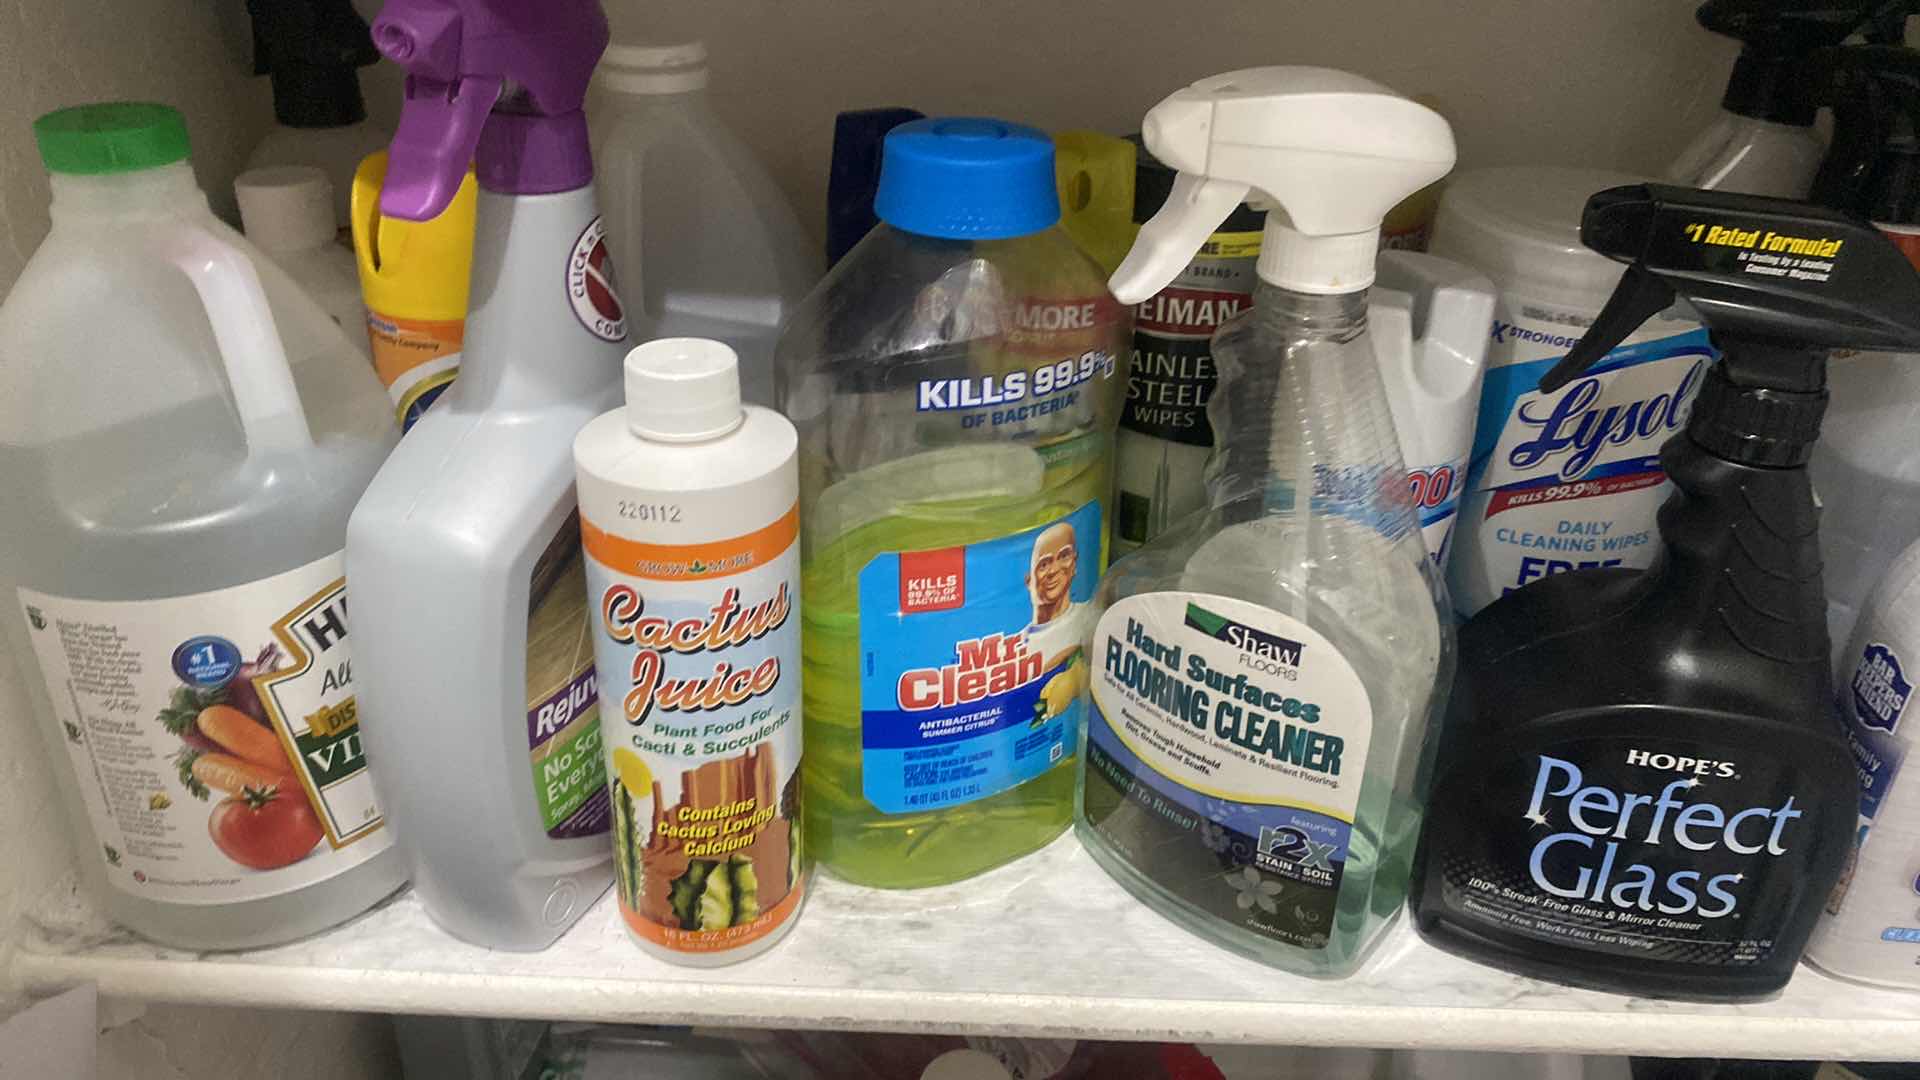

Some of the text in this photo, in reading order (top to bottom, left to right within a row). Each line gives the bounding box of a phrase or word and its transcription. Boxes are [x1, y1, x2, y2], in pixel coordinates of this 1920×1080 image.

[1684, 223, 1843, 257] #1 Rated Formula!
[573, 247, 589, 298] CLICK
[1016, 303, 1096, 330] MORE
[1139, 297, 1239, 326] EIMAN
[1131, 349, 1218, 380] AINLE
[919, 350, 1116, 411] KILLS 99.9%
[1128, 376, 1208, 407] STEEL
[961, 412, 986, 430] OF
[1134, 404, 1196, 428] WIPES
[1508, 358, 1706, 479] Lysol
[1507, 491, 1544, 506] KILLS
[1544, 482, 1601, 501] 99.9%
[616, 500, 682, 522] 220112
[1496, 528, 1649, 552] CLEANING WIPES
[1557, 520, 1613, 535] DAILY
[908, 575, 957, 591] KILLS
[304, 597, 348, 652] H
[601, 581, 791, 654] Cactus
[956, 632, 1028, 673] Mr.
[1227, 625, 1298, 666] Shaw
[898, 650, 1044, 710] Clean
[1127, 615, 1321, 724] Hard Surfaces
[1239, 653, 1297, 681] FLOORS
[1871, 652, 1896, 685] BAR
[623, 648, 780, 726] Juice
[328, 700, 356, 730] DIS
[653, 703, 774, 738] Plant Food For
[918, 706, 1003, 730] ANTIBACTERIAL
[1105, 634, 1344, 776] FLOORING CLEANER
[631, 710, 791, 756] Cacti & Succulents
[922, 725, 963, 739] SUMMER
[543, 752, 572, 783] No
[575, 727, 600, 760] Scr
[1153, 728, 1175, 748] Tough
[1176, 742, 1221, 770] Household
[1167, 749, 1184, 763] and
[1626, 748, 1736, 779] HOPE'S
[678, 797, 757, 822] Contains
[1136, 784, 1152, 805] To
[1525, 755, 1801, 856] Perfect
[656, 804, 776, 839] Cactus Loving
[1290, 815, 1337, 837] featuring
[683, 832, 756, 857] Calcium
[1256, 852, 1333, 881] STAIN SOIL
[1528, 831, 1740, 918] Glass
[1570, 903, 1604, 918] Glass
[1604, 908, 1615, 920] &
[1617, 912, 1656, 926] Mirror
[1657, 918, 1702, 931] Cleaner
